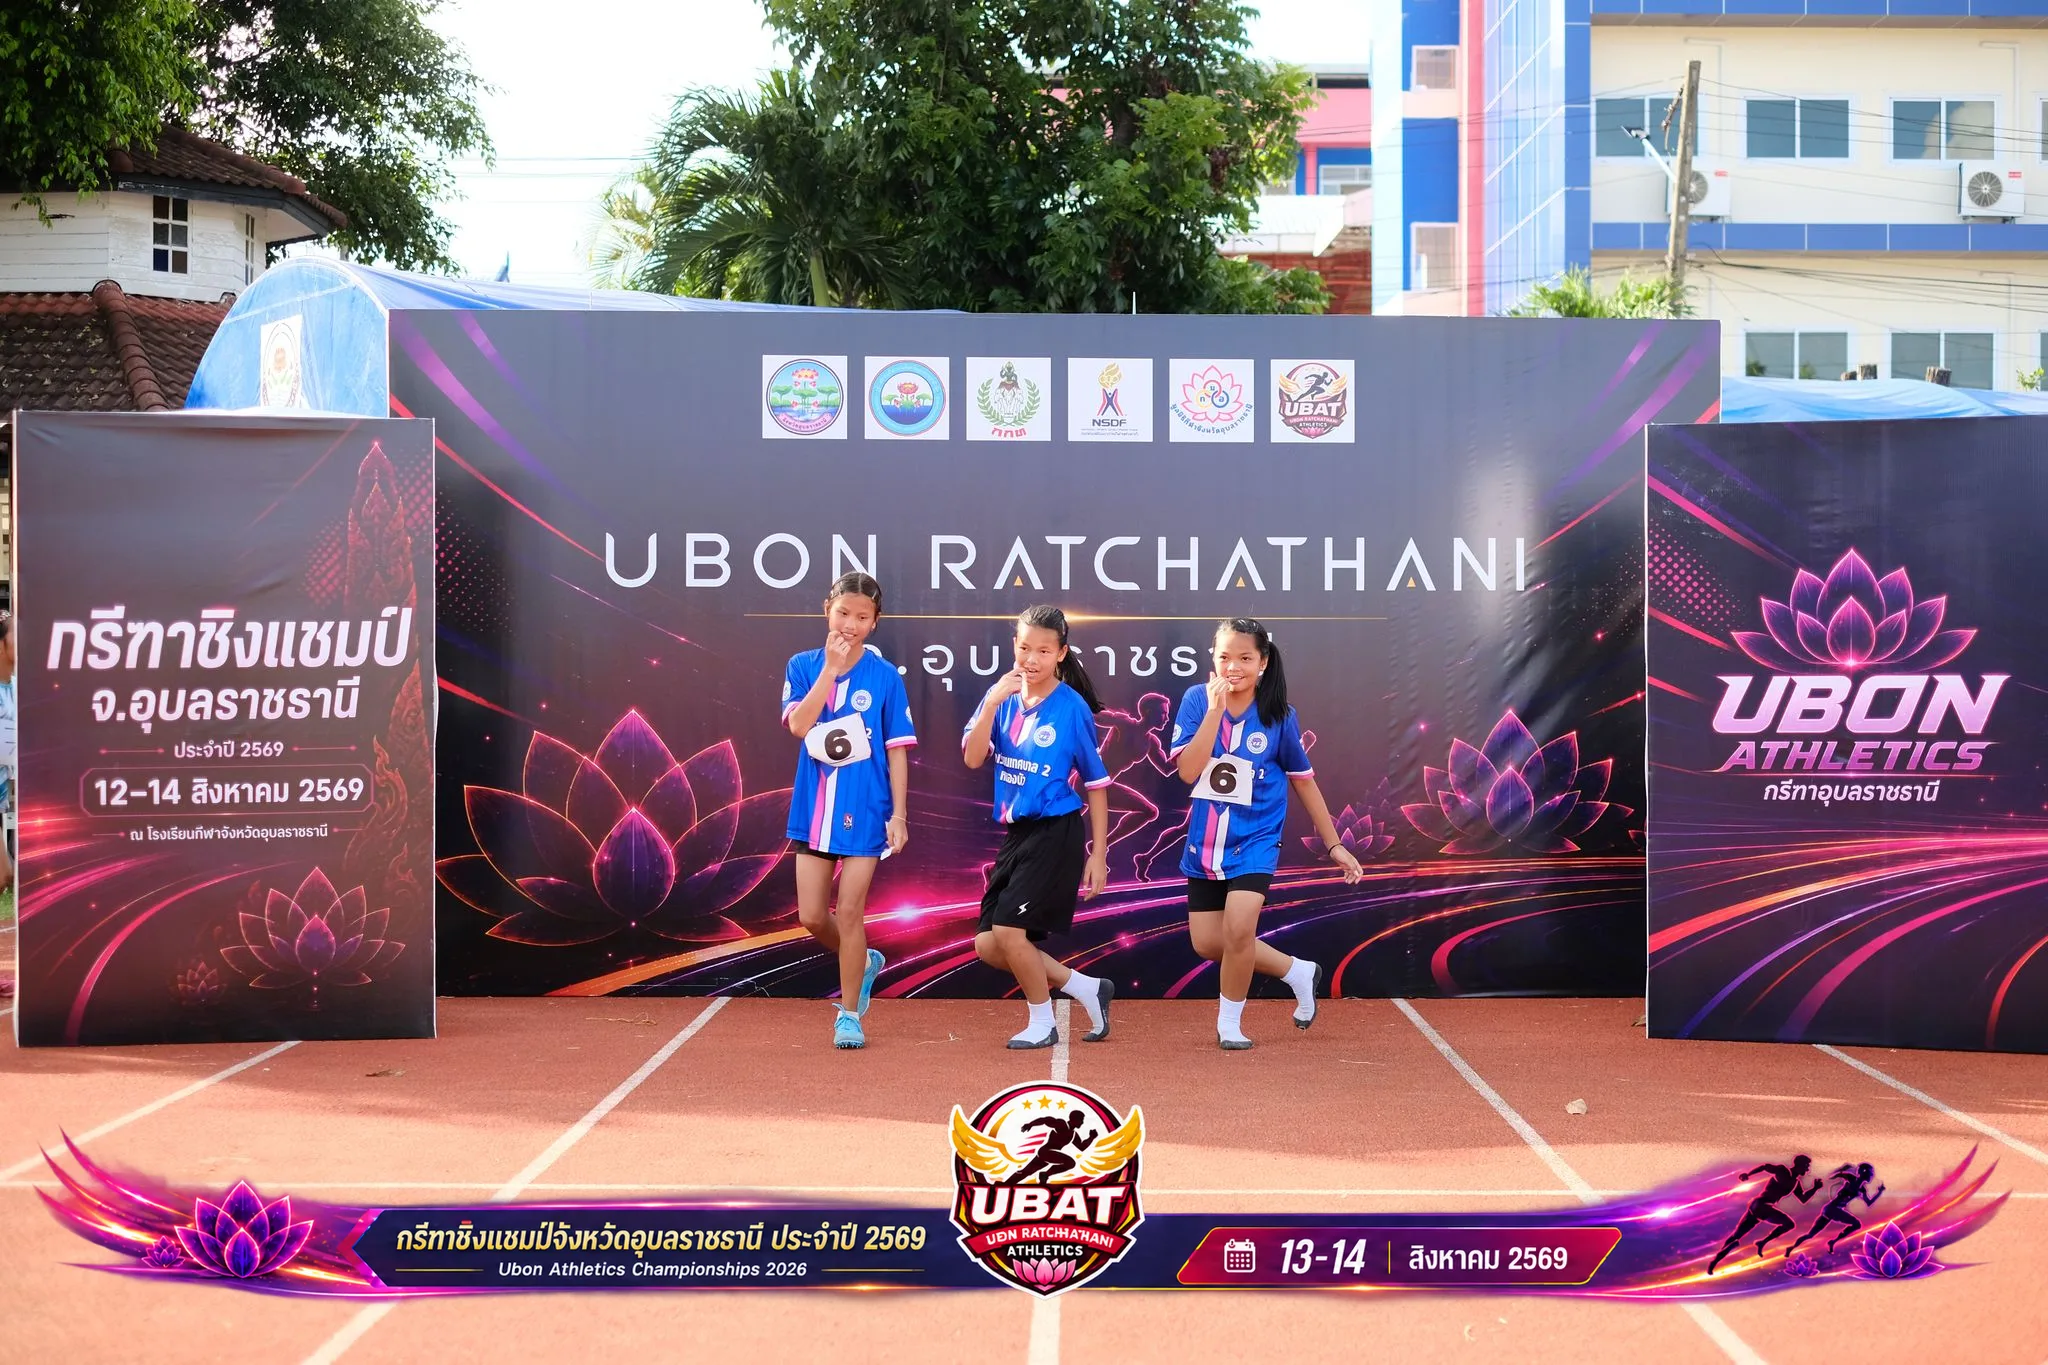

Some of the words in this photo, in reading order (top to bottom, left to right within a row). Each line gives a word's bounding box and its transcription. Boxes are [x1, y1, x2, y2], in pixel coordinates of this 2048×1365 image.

[1092, 419, 1127, 427] NSDF
[1284, 401, 1342, 417] UBAT
[605, 532, 877, 589] UBON
[931, 534, 1525, 591] RATCHATHANI
[91, 675, 361, 734] จ.อุบลราชธานี
[1712, 674, 2012, 734] UBON
[174, 740, 235, 758] ประจำปี
[240, 741, 284, 757] 2569
[824, 728, 852, 761] 6
[1720, 741, 1998, 772] ATHLETICS
[1041, 764, 1052, 777] 2
[1209, 762, 1238, 795] 6
[94, 778, 181, 806] 12-14
[191, 778, 290, 804] สิงหาคม
[299, 777, 364, 802] 2569
